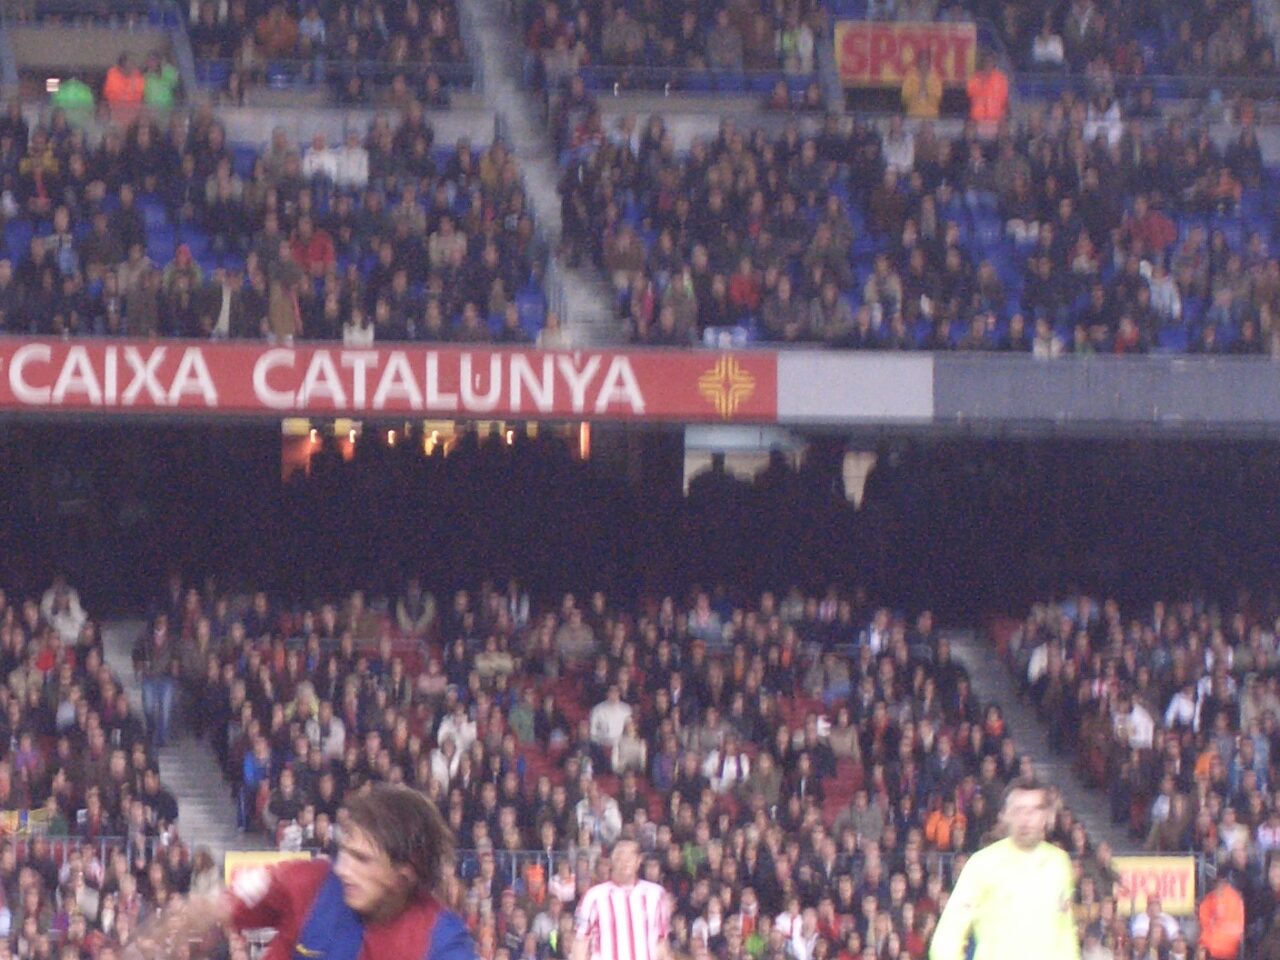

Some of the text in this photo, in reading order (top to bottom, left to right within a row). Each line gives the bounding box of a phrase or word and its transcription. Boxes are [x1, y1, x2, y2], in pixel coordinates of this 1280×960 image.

[840, 29, 971, 78] SPORT
[8, 343, 646, 415] CAIXA CATALUNYA
